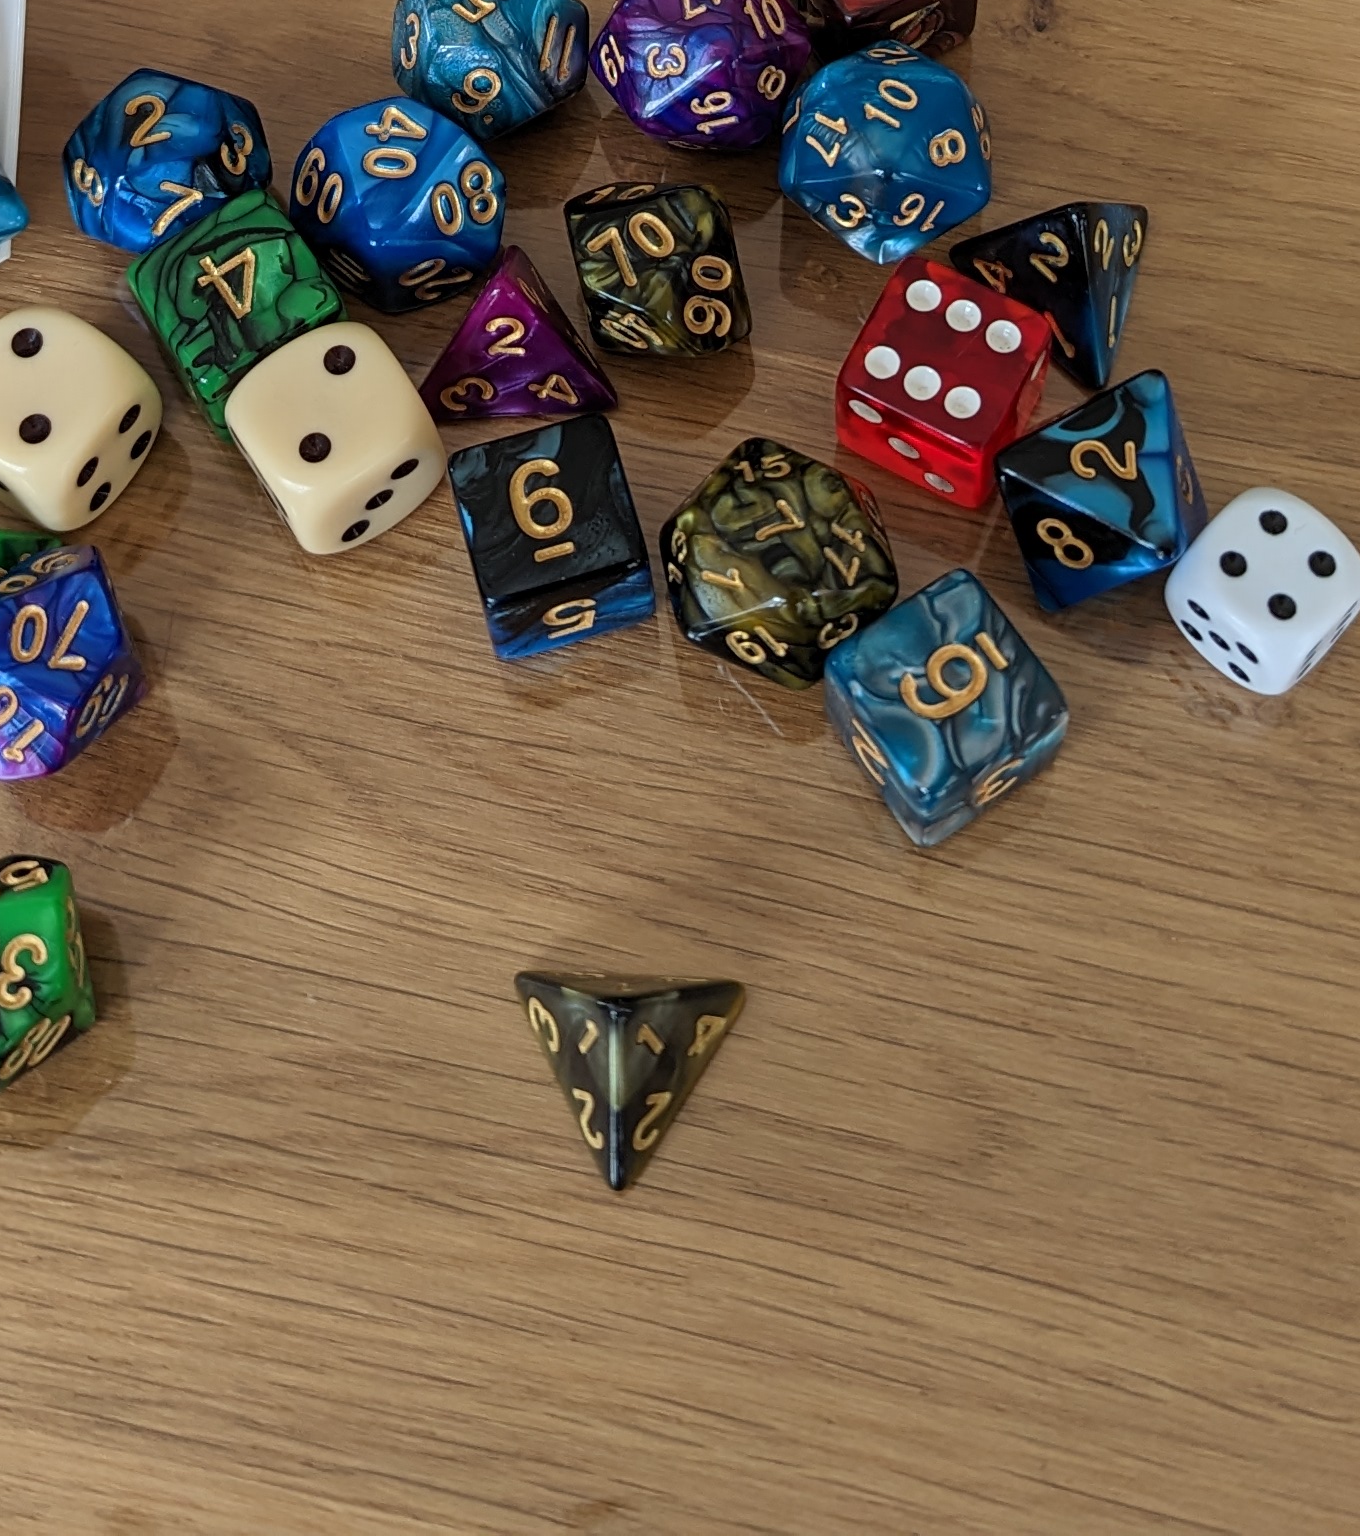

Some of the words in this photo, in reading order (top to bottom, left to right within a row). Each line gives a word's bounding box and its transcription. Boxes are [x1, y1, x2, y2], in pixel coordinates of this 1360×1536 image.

[400, 13, 420, 70] 3
[540, 15, 576, 82] 11
[599, 35, 625, 88] 19
[646, 42, 687, 80] 3
[757, 65, 786, 101] 8
[863, 78, 919, 129] 10
[125, 94, 172, 148] 2
[690, 91, 740, 135] 16
[220, 123, 253, 175] 3
[363, 106, 428, 179] 40
[805, 110, 848, 168] 17
[928, 128, 967, 167] 8
[153, 181, 204, 237] 7
[295, 147, 343, 224] 60
[431, 160, 498, 236] 80
[826, 192, 868, 229] 3
[892, 192, 945, 232] 16
[586, 212, 675, 287] 70
[1029, 231, 1069, 283] 2
[1094, 218, 1114, 271] 2
[1123, 219, 1141, 267] 3
[197, 247, 256, 320] 4
[485, 317, 526, 357] 2
[440, 376, 494, 411] 3
[528, 374, 578, 405] 4
[733, 454, 791, 483] 15
[1069, 439, 1138, 481] 2
[755, 499, 805, 541] 7
[1036, 517, 1094, 570] 8
[823, 521, 865, 587] 17
[10, 599, 89, 672] 70
[542, 598, 597, 639] 5
[817, 613, 859, 650] 3
[725, 625, 789, 665] 19
[528, 996, 561, 1054] 3
[577, 1019, 600, 1055] 1
[636, 1023, 665, 1055] 1
[687, 1015, 727, 1057] 4
[572, 1087, 605, 1150] 2
[632, 1091, 673, 1151] 2
